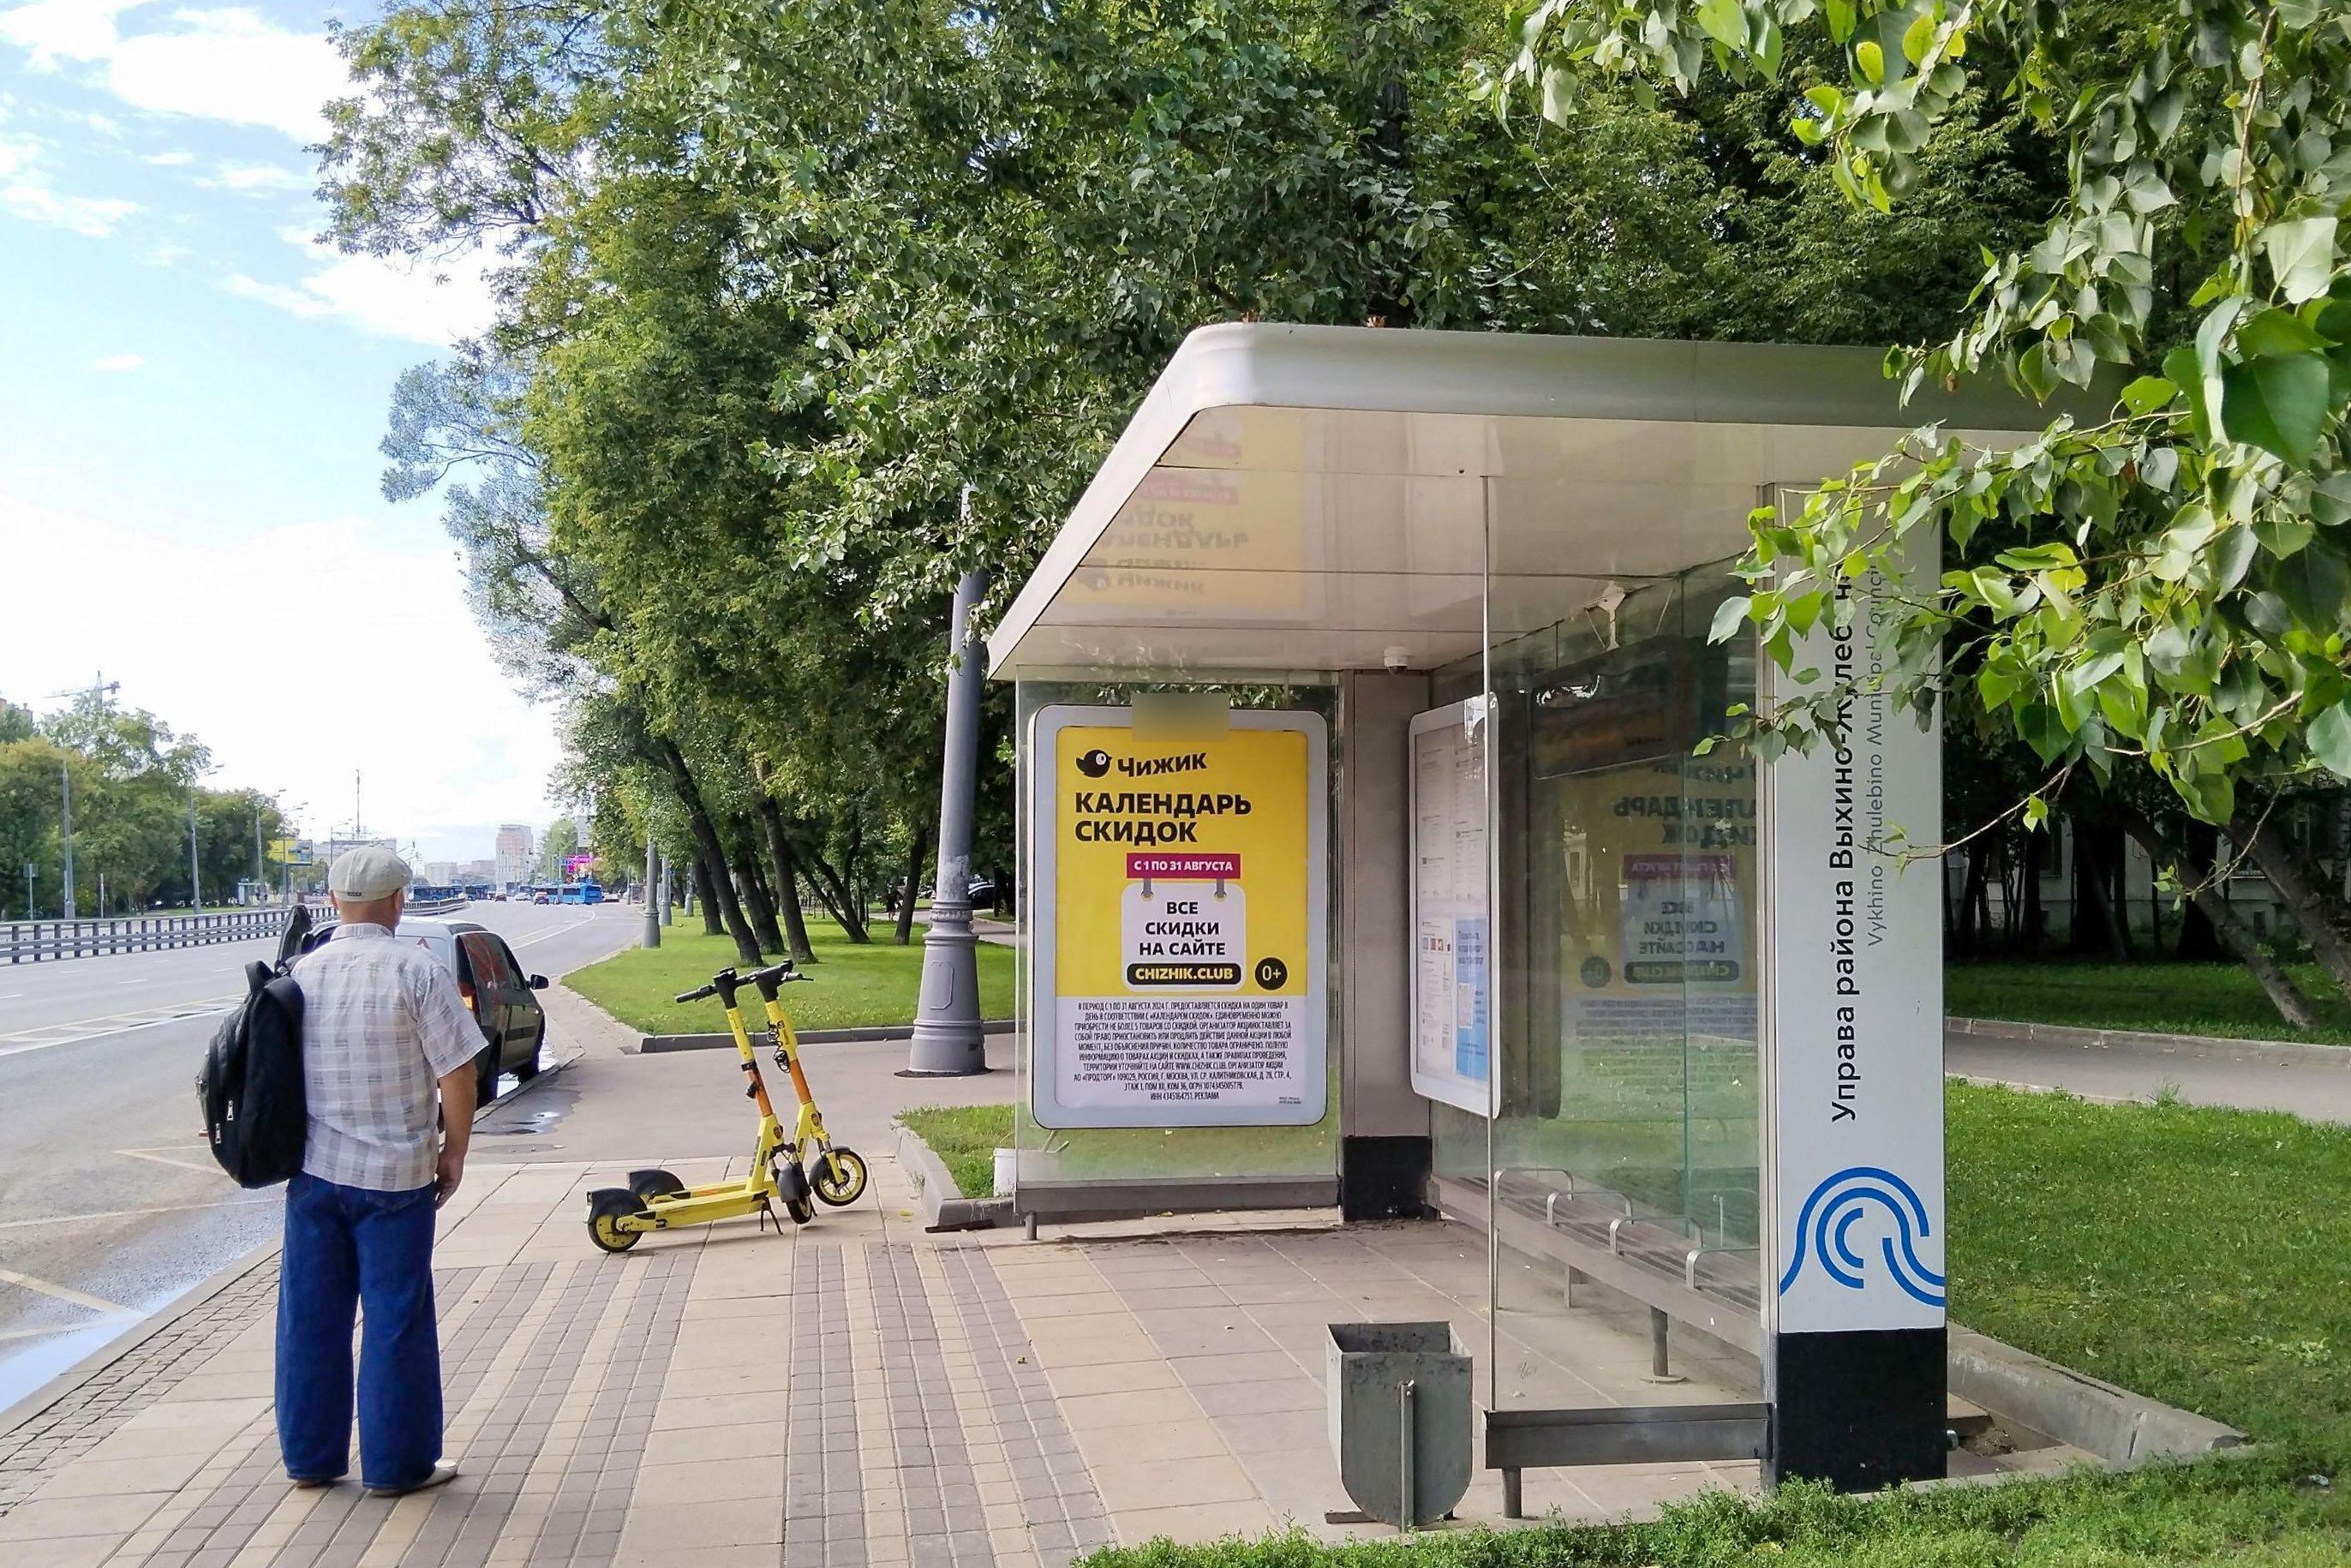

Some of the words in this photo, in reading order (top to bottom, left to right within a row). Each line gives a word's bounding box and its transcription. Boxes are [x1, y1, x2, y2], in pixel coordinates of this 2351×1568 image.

[1828, 562, 1858, 869] Выхино-Жлебн
[1117, 753, 1207, 777] Чижик
[1075, 793, 1251, 818] КАЛЕНДАРЬ
[1075, 821, 1197, 846] СКИДОК
[1134, 861, 1141, 871] С
[1144, 861, 1149, 871] 1
[1152, 861, 1167, 871] ПО
[1170, 861, 1181, 871] 31
[1184, 861, 1233, 871] АВГУСТА
[1166, 901, 1198, 914] ВСЕ
[1866, 865, 1887, 946] Vykhino
[1145, 922, 1219, 937] СКИДКИ
[1829, 881, 1860, 996] района
[1140, 943, 1164, 955] НА
[1170, 939, 1225, 955] САЙТЕ
[1134, 968, 1234, 980] CHIZHIK.CLUB
[1262, 967, 1282, 981] 0+
[1128, 1002, 1151, 1010] АВГУСТА
[1152, 1002, 1165, 1010] 2024
[1830, 1007, 1860, 1122] Управа
